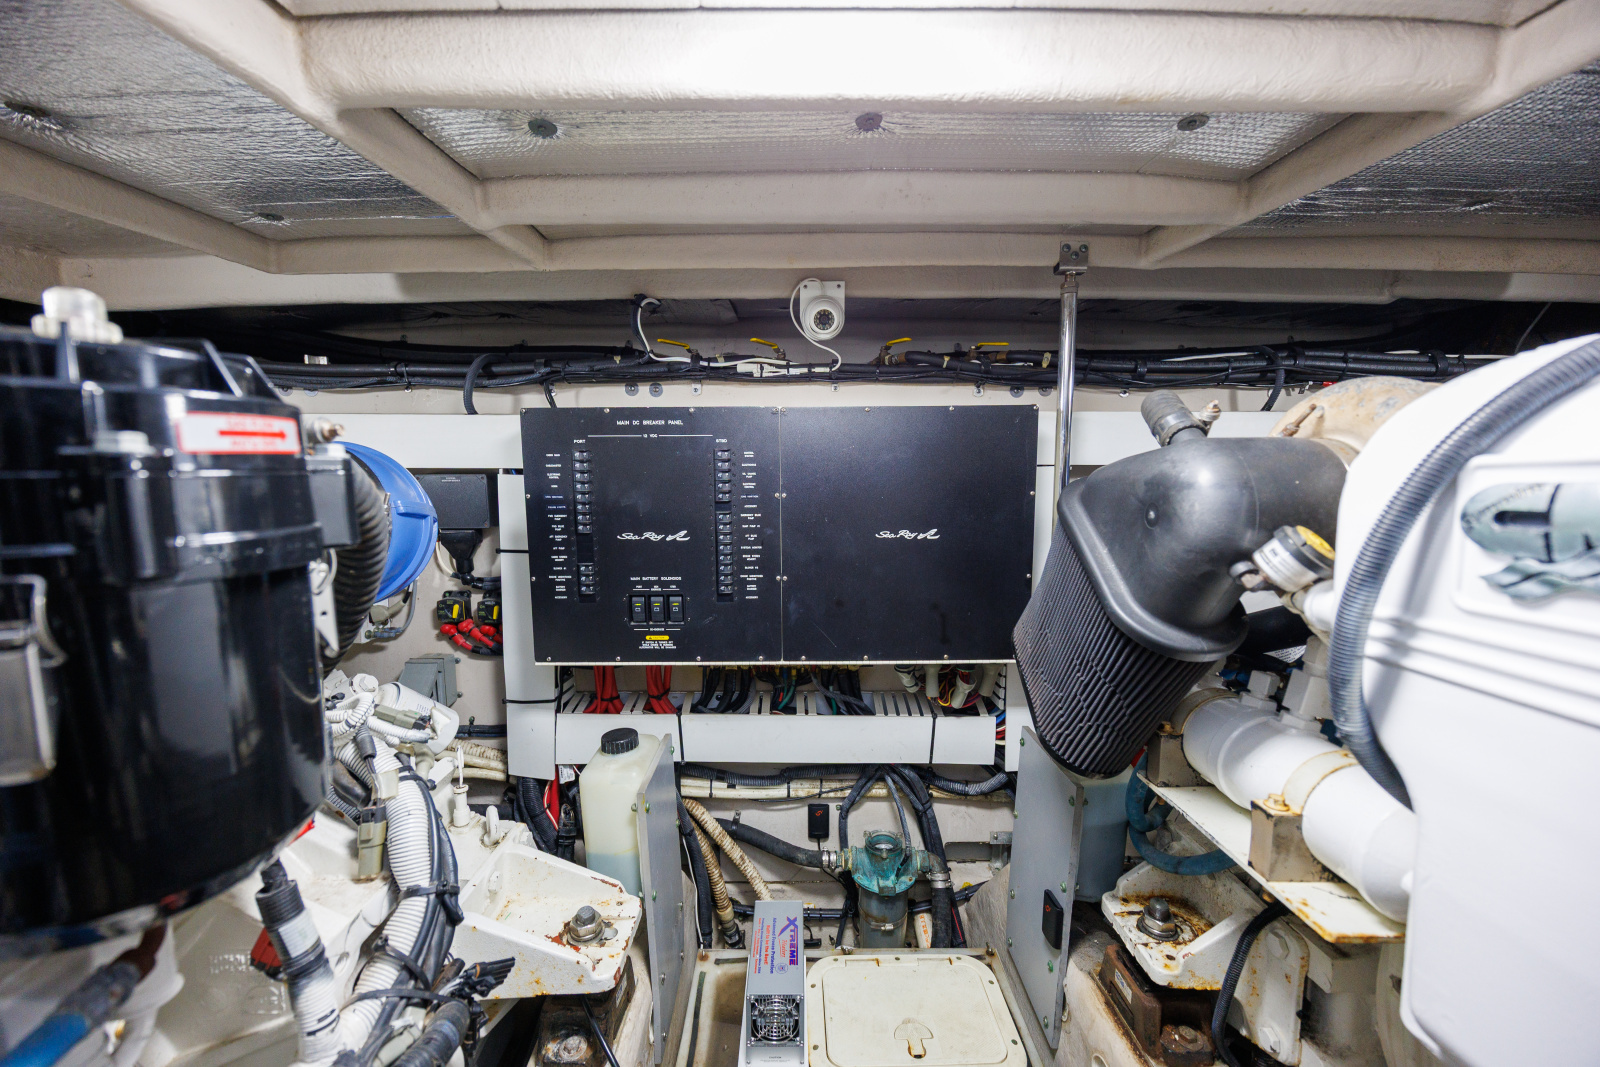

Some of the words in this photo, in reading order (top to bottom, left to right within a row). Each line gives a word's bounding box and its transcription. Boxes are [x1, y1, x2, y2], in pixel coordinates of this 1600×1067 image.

[641, 532, 665, 541] Ray
[875, 530, 897, 539] Sea
[897, 530, 918, 540] Ray
[777, 916, 798, 966] XTREME
